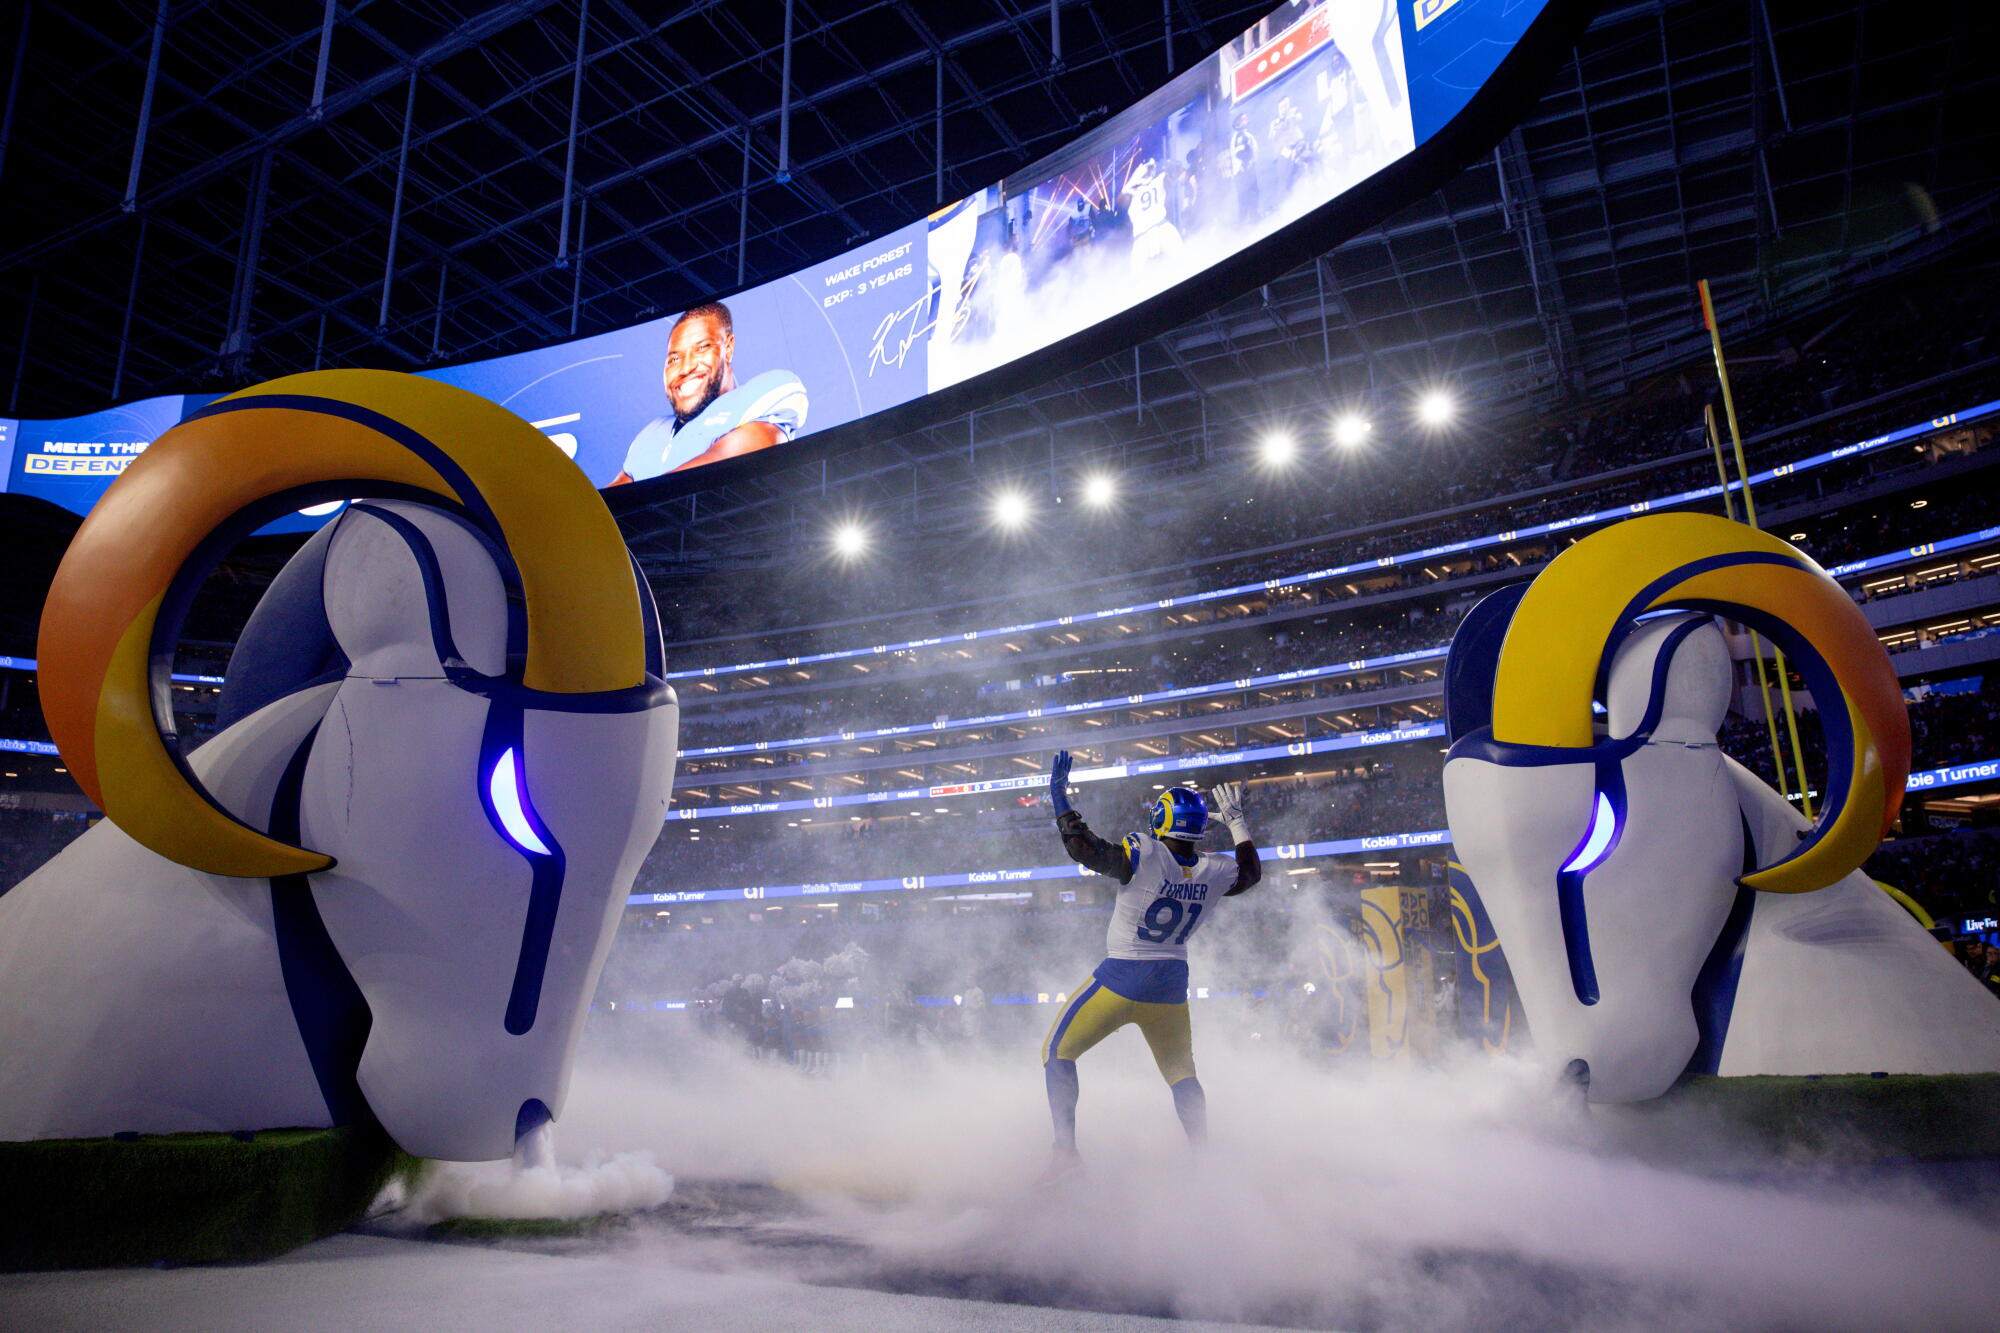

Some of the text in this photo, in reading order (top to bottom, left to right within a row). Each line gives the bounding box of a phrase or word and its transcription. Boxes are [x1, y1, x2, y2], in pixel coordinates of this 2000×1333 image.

[1140, 187, 1158, 211] 91
[825, 242, 913, 286] WAKE FOREST
[823, 264, 913, 308] EXP: 3 YEARS
[43, 441, 105, 454] MEET
[1832, 435, 1891, 459] Kobie Turner
[1549, 514, 1596, 530] Kobie Turner
[1837, 562, 1867, 576] Turner
[1361, 727, 1430, 744] Kobie Turner
[1936, 763, 1998, 783] Turner
[731, 803, 780, 814] Kobie Turner
[1361, 833, 1443, 849] Kobie Turner
[969, 870, 1032, 883] Kobie Turner
[654, 891, 706, 902] Kobie Turner
[1160, 879, 1208, 901] TURNER
[1137, 897, 1203, 945] 91
